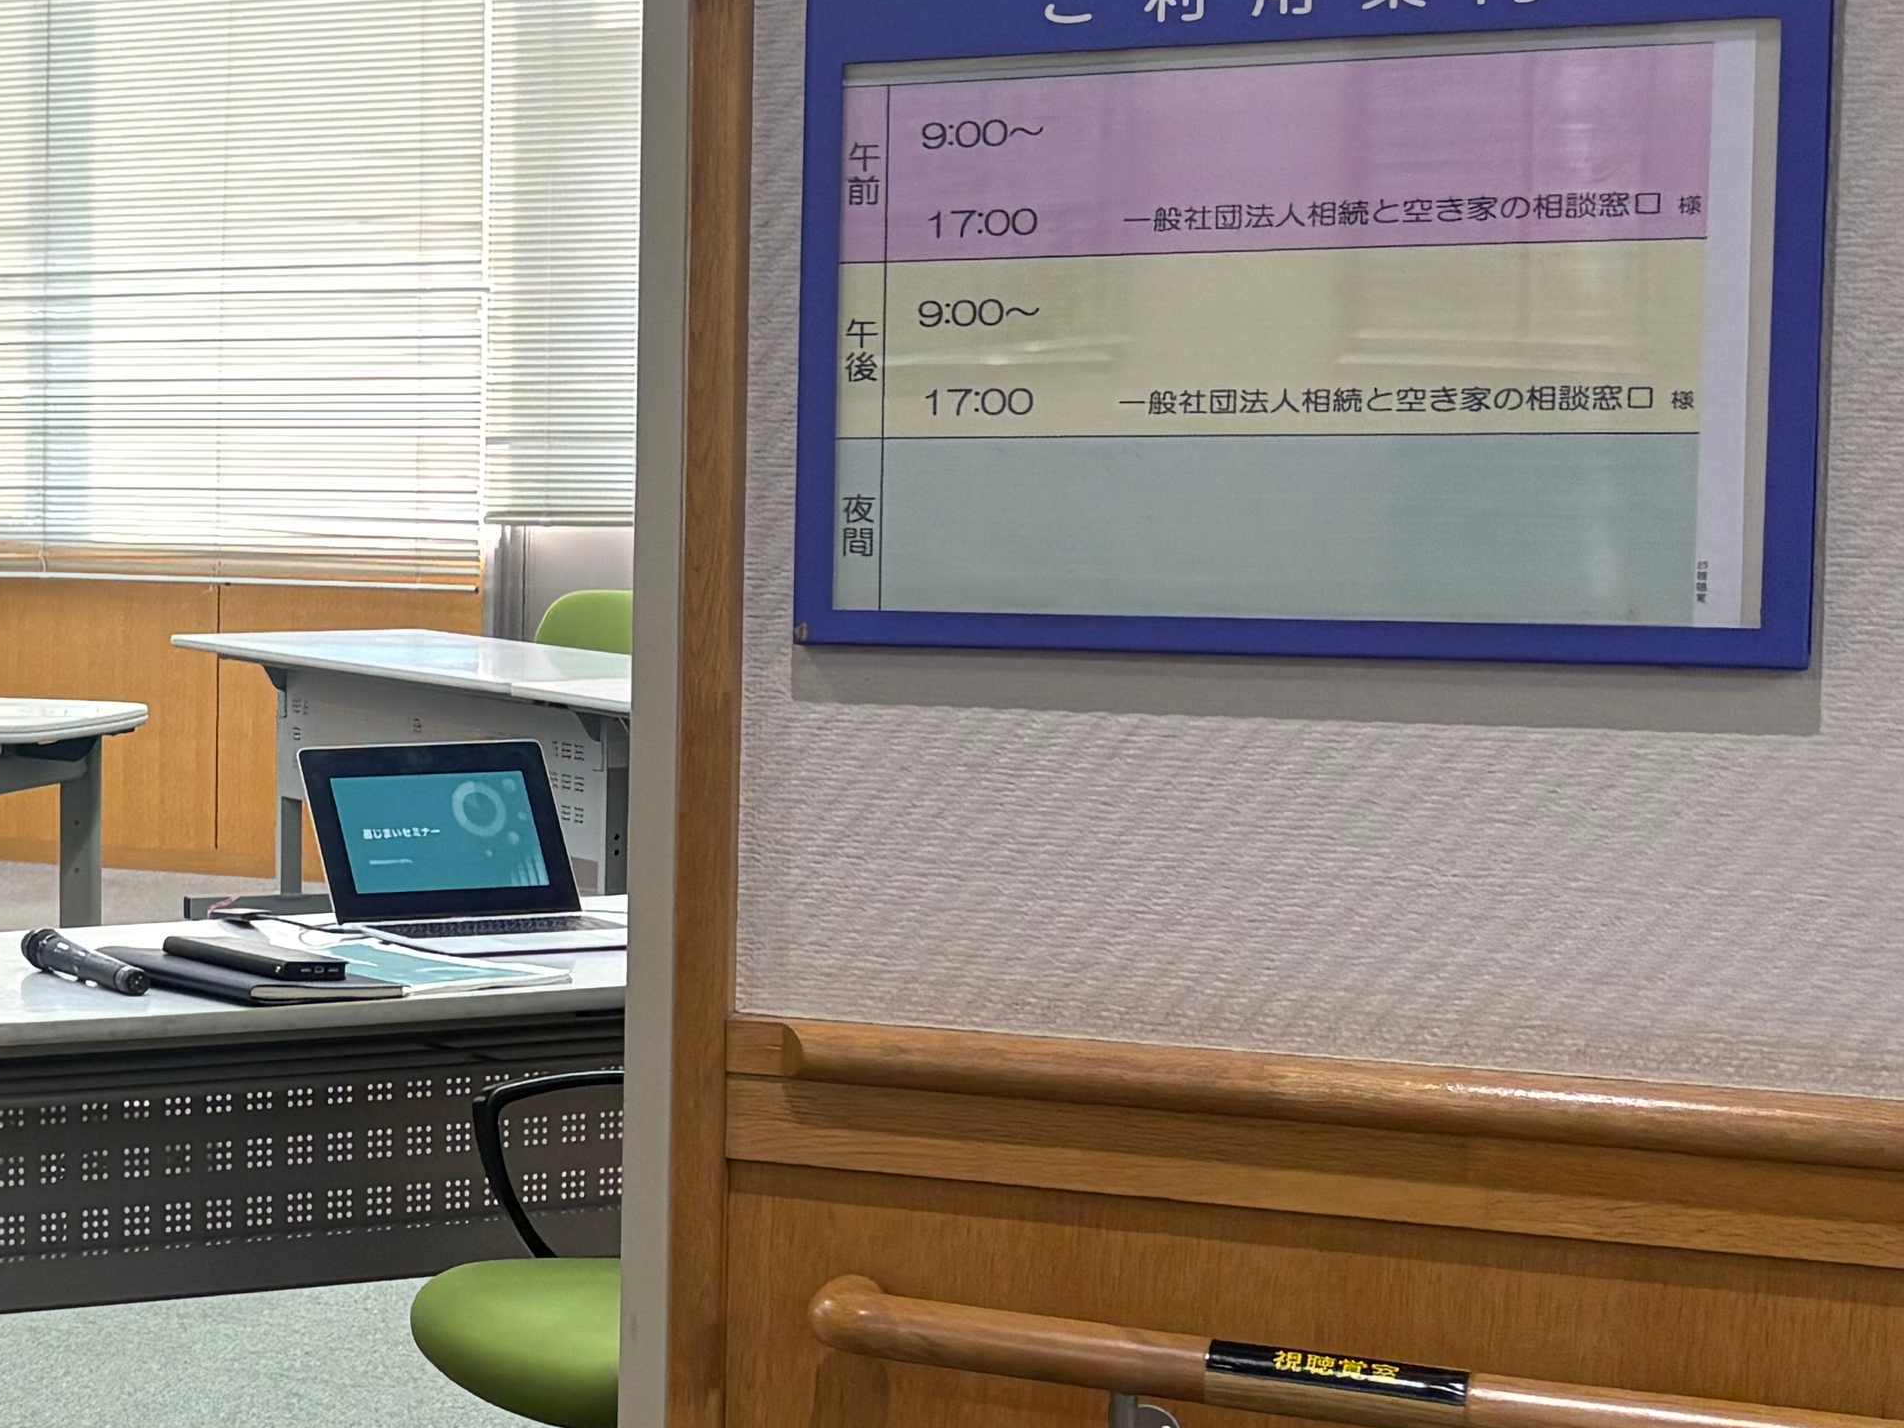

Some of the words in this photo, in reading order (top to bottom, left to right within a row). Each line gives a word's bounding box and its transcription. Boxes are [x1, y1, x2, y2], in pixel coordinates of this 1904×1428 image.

[847, 142, 881, 207] 午前
[928, 207, 1038, 240] 17:00
[1123, 191, 1662, 232] 一般社団法人相続と空き家の相談窓口
[1678, 194, 1704, 217] 様
[844, 319, 879, 383] 午後
[924, 387, 1034, 417] 17:00
[1118, 384, 1654, 416] 一般社団法人相続と空き家の相談窓口
[1671, 388, 1696, 412] 様
[842, 492, 876, 558] 夜間
